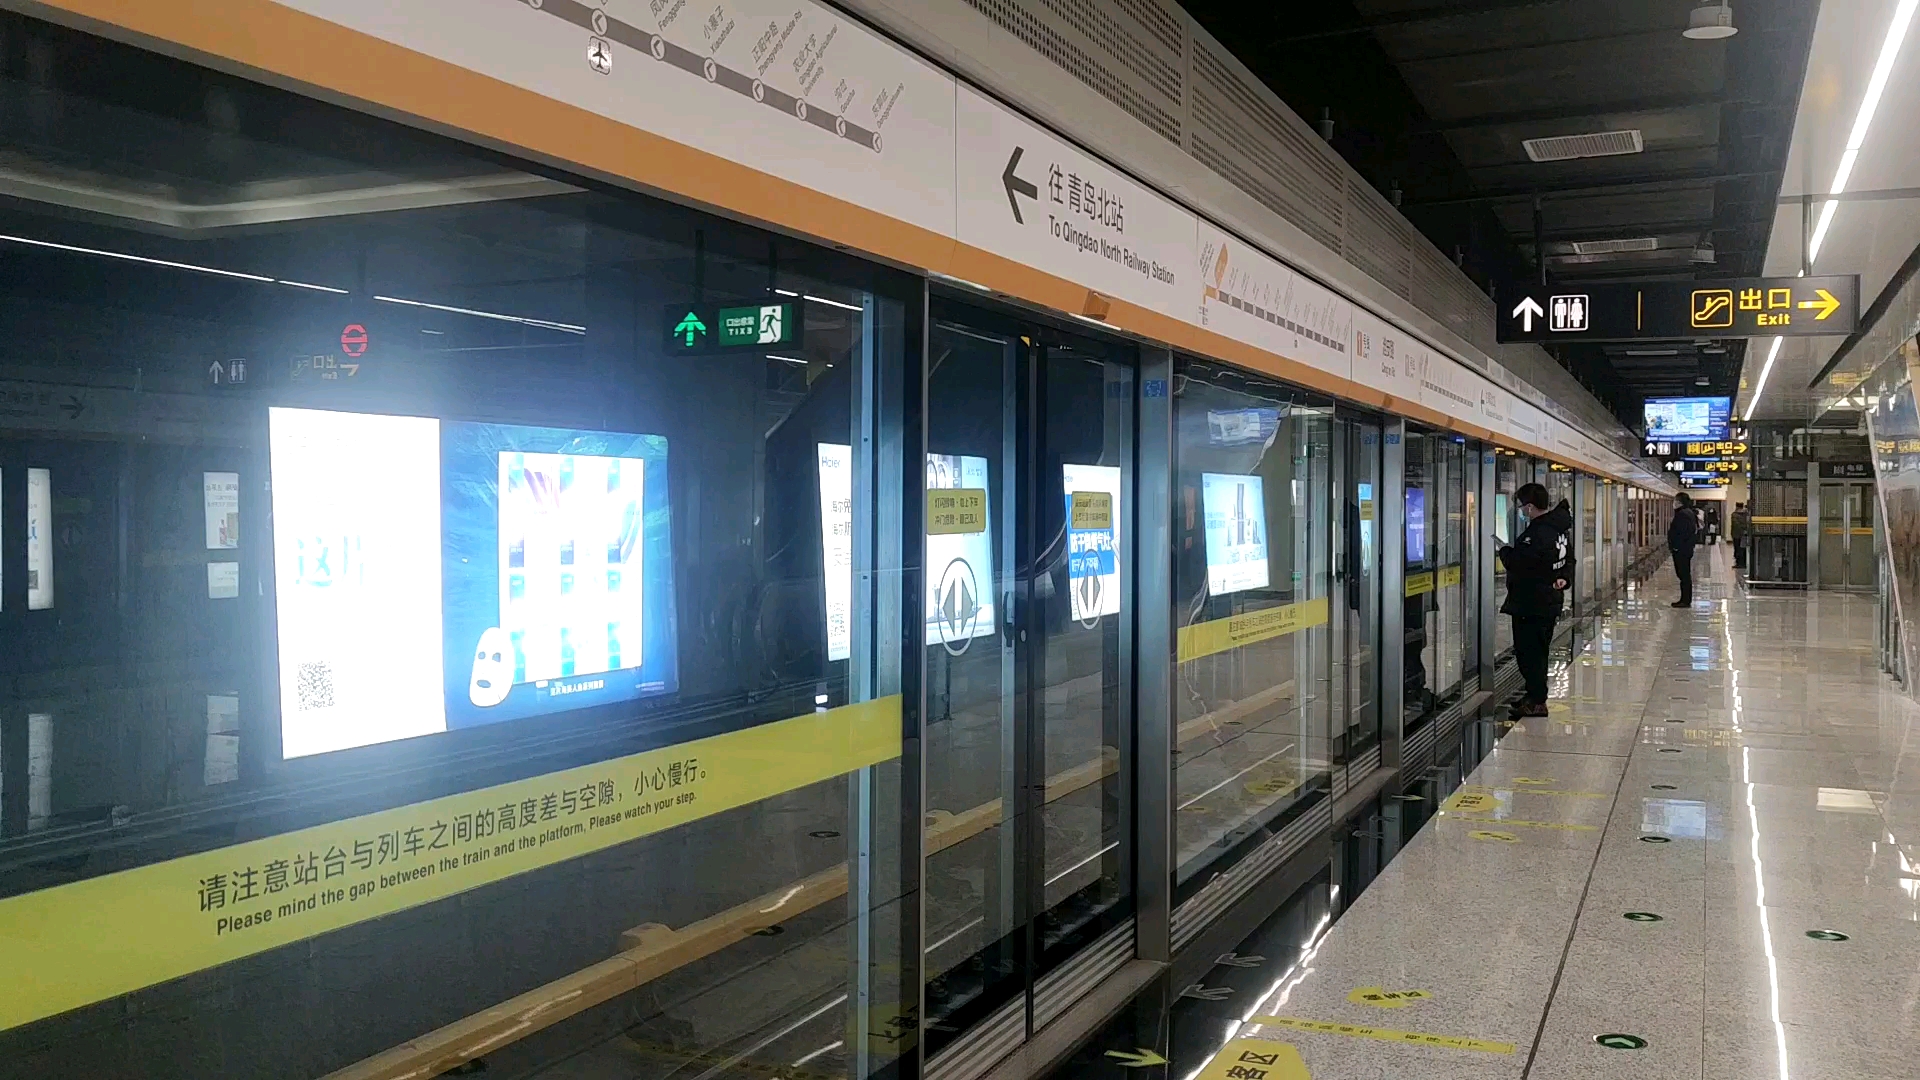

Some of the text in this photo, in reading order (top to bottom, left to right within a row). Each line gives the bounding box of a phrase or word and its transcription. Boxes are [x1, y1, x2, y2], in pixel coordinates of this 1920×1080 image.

[1048, 162, 1124, 235] 往青岛北站
[1048, 214, 1061, 238] To
[1062, 221, 1099, 253] Qingdao
[1100, 238, 1122, 264] North
[1123, 247, 1151, 280] Railway
[1152, 261, 1175, 285] Station
[1739, 288, 1791, 310] 出口
[1757, 313, 1791, 326] Exit
[198, 758, 707, 913] 请注意站台与列车之间的高度差与空隙，小心慢行。
[217, 791, 697, 935] Please mind the gap between the train and the platform, Please watch your step.
